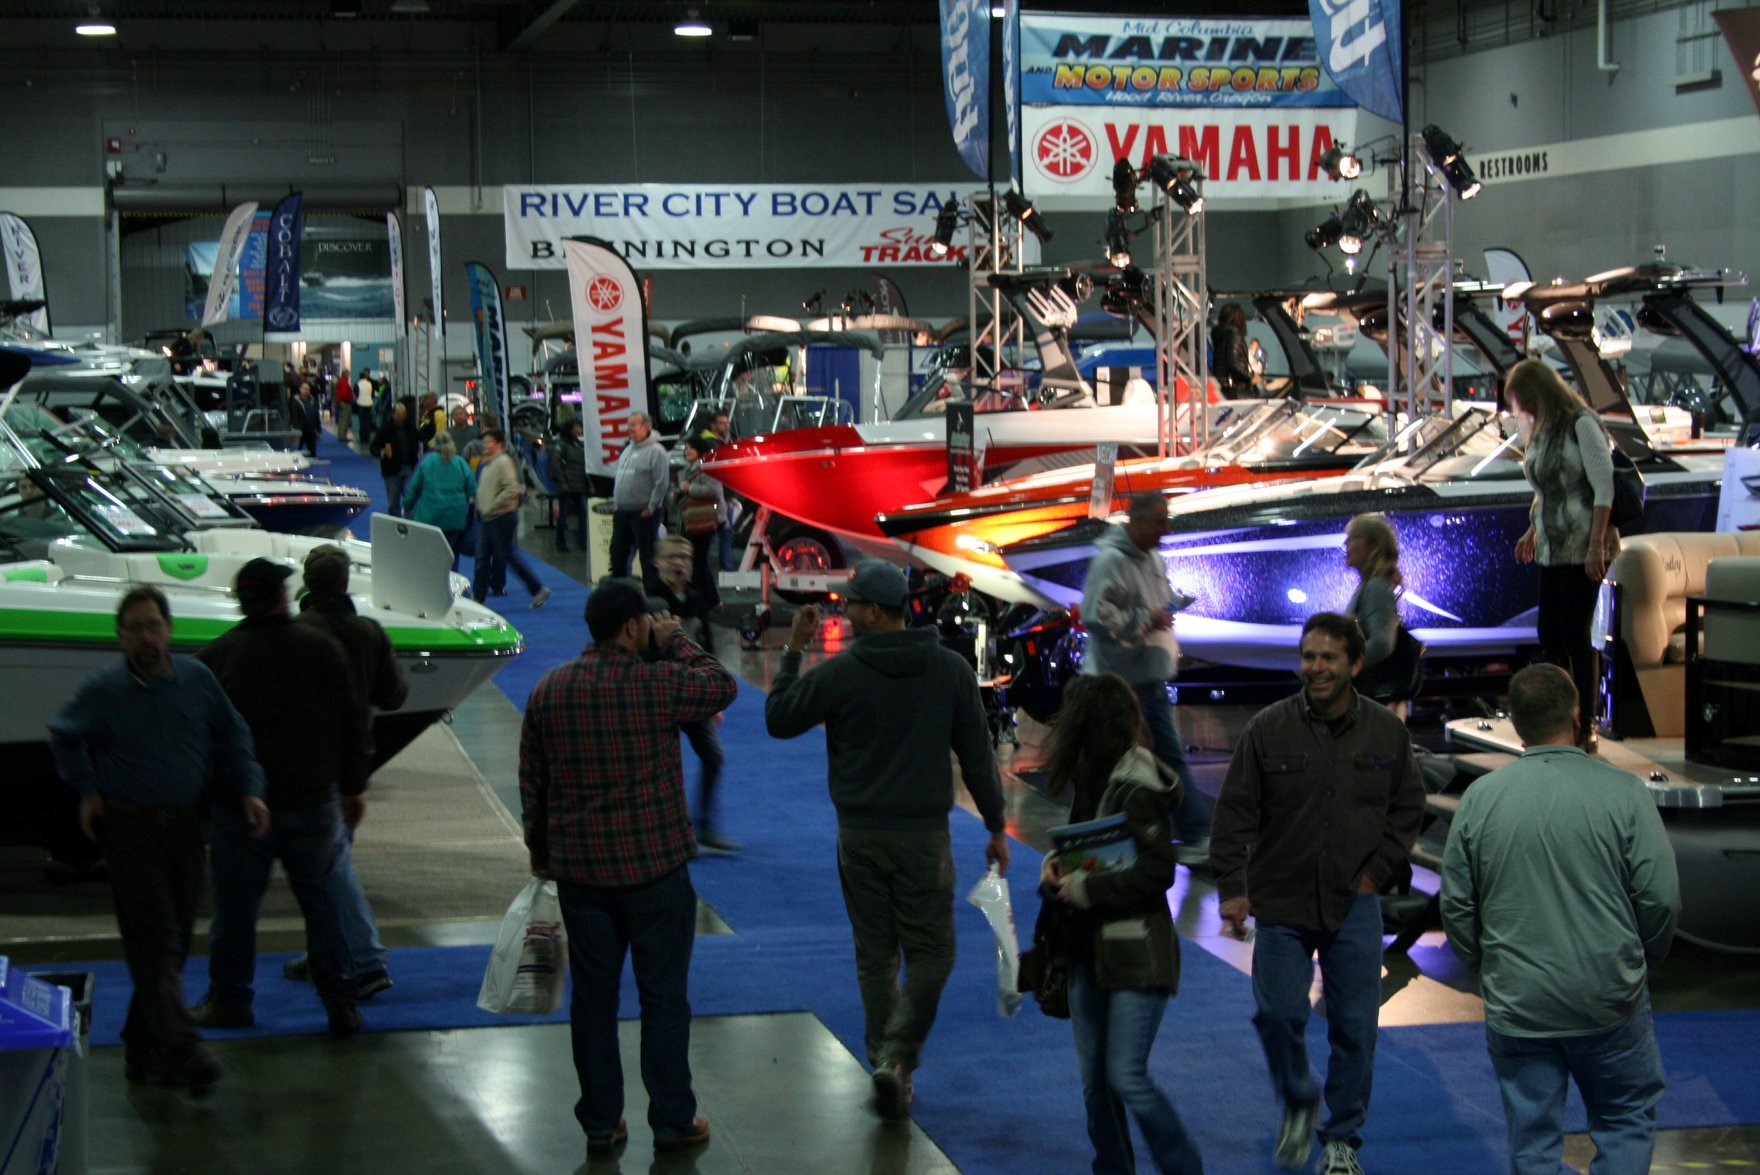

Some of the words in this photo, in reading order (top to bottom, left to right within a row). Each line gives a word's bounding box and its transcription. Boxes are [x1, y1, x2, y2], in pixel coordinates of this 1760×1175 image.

[1123, 19, 1159, 34] Mid
[1166, 19, 1254, 35] Columbia
[1053, 33, 1316, 61] MARINE
[1027, 66, 1053, 76] AND
[1054, 64, 1184, 90] MOTOR
[1187, 65, 1320, 92] SPORTS
[1105, 90, 1153, 102] Hood
[1104, 123, 1340, 181] YAMAHA
[1480, 151, 1548, 179] RESTROOMS
[520, 193, 649, 217] RIVER
[662, 192, 757, 217] CITY
[771, 191, 881, 216] BOAT
[530, 239, 825, 259] BNINGTON
[860, 243, 1005, 262] TRACK
[591, 317, 631, 465] YAMAHA
